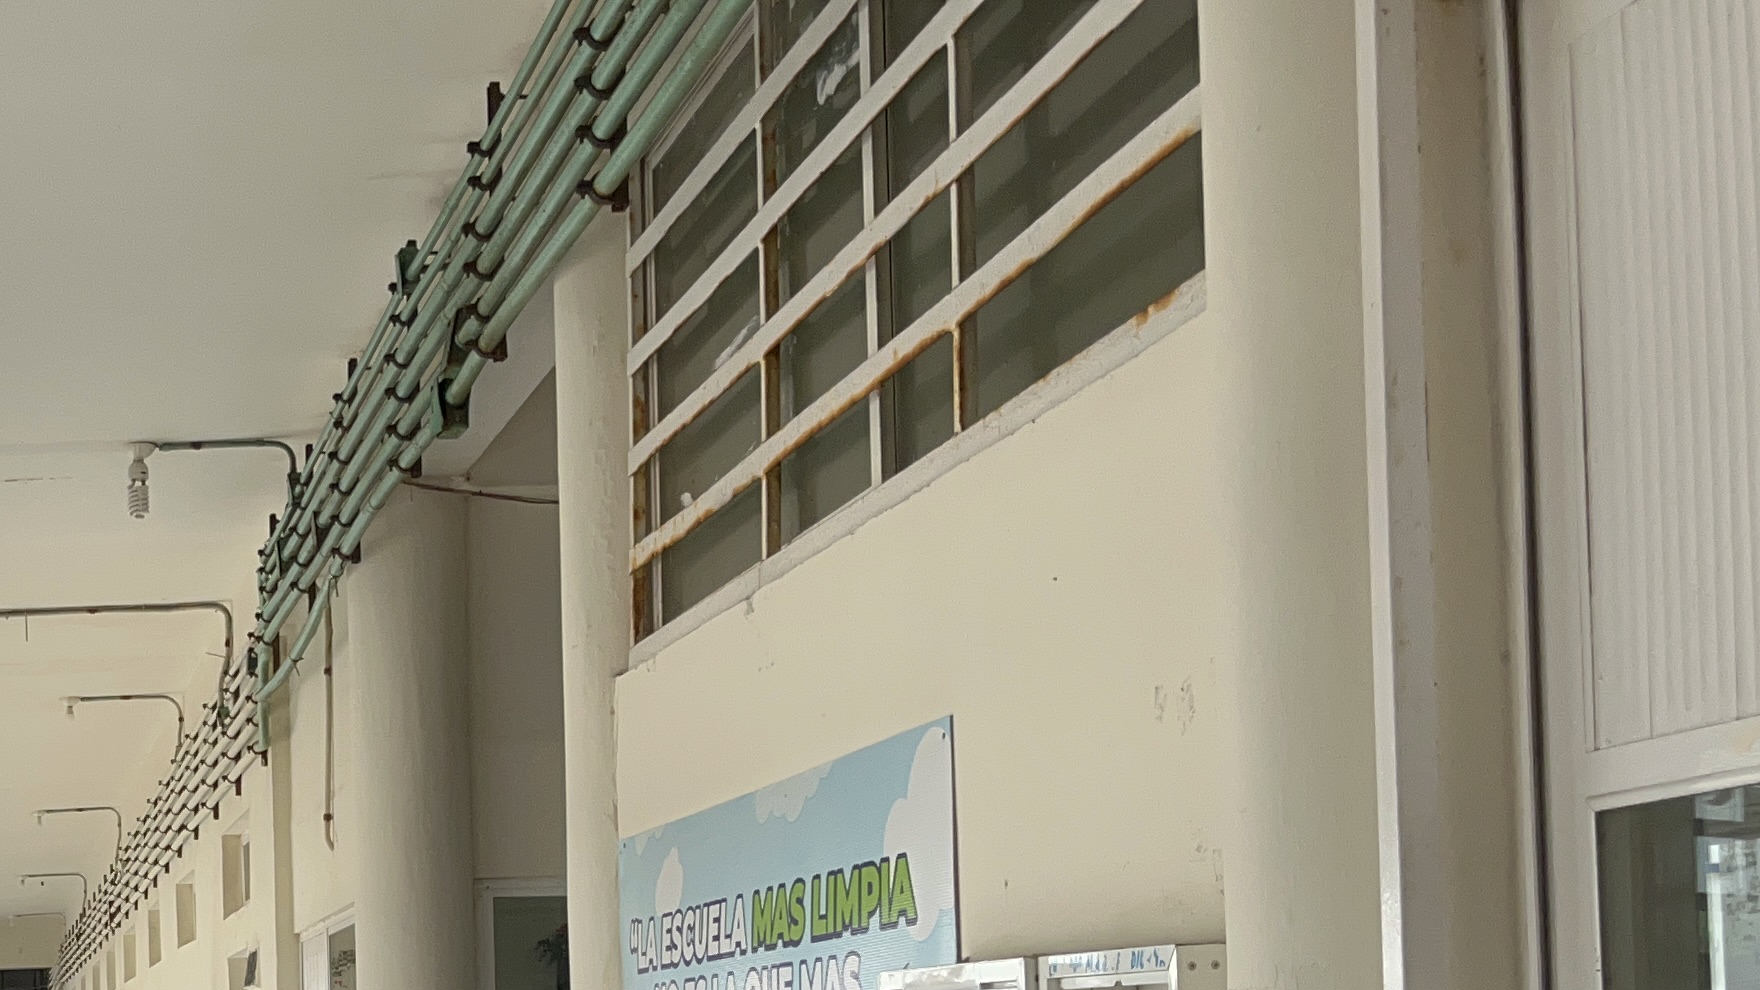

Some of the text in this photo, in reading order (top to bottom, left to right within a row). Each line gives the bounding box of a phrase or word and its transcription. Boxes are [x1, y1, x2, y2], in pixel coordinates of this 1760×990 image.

[661, 893, 747, 970] ESCUELA
[751, 877, 806, 953] MAS
[811, 852, 918, 943] LIMPIA
